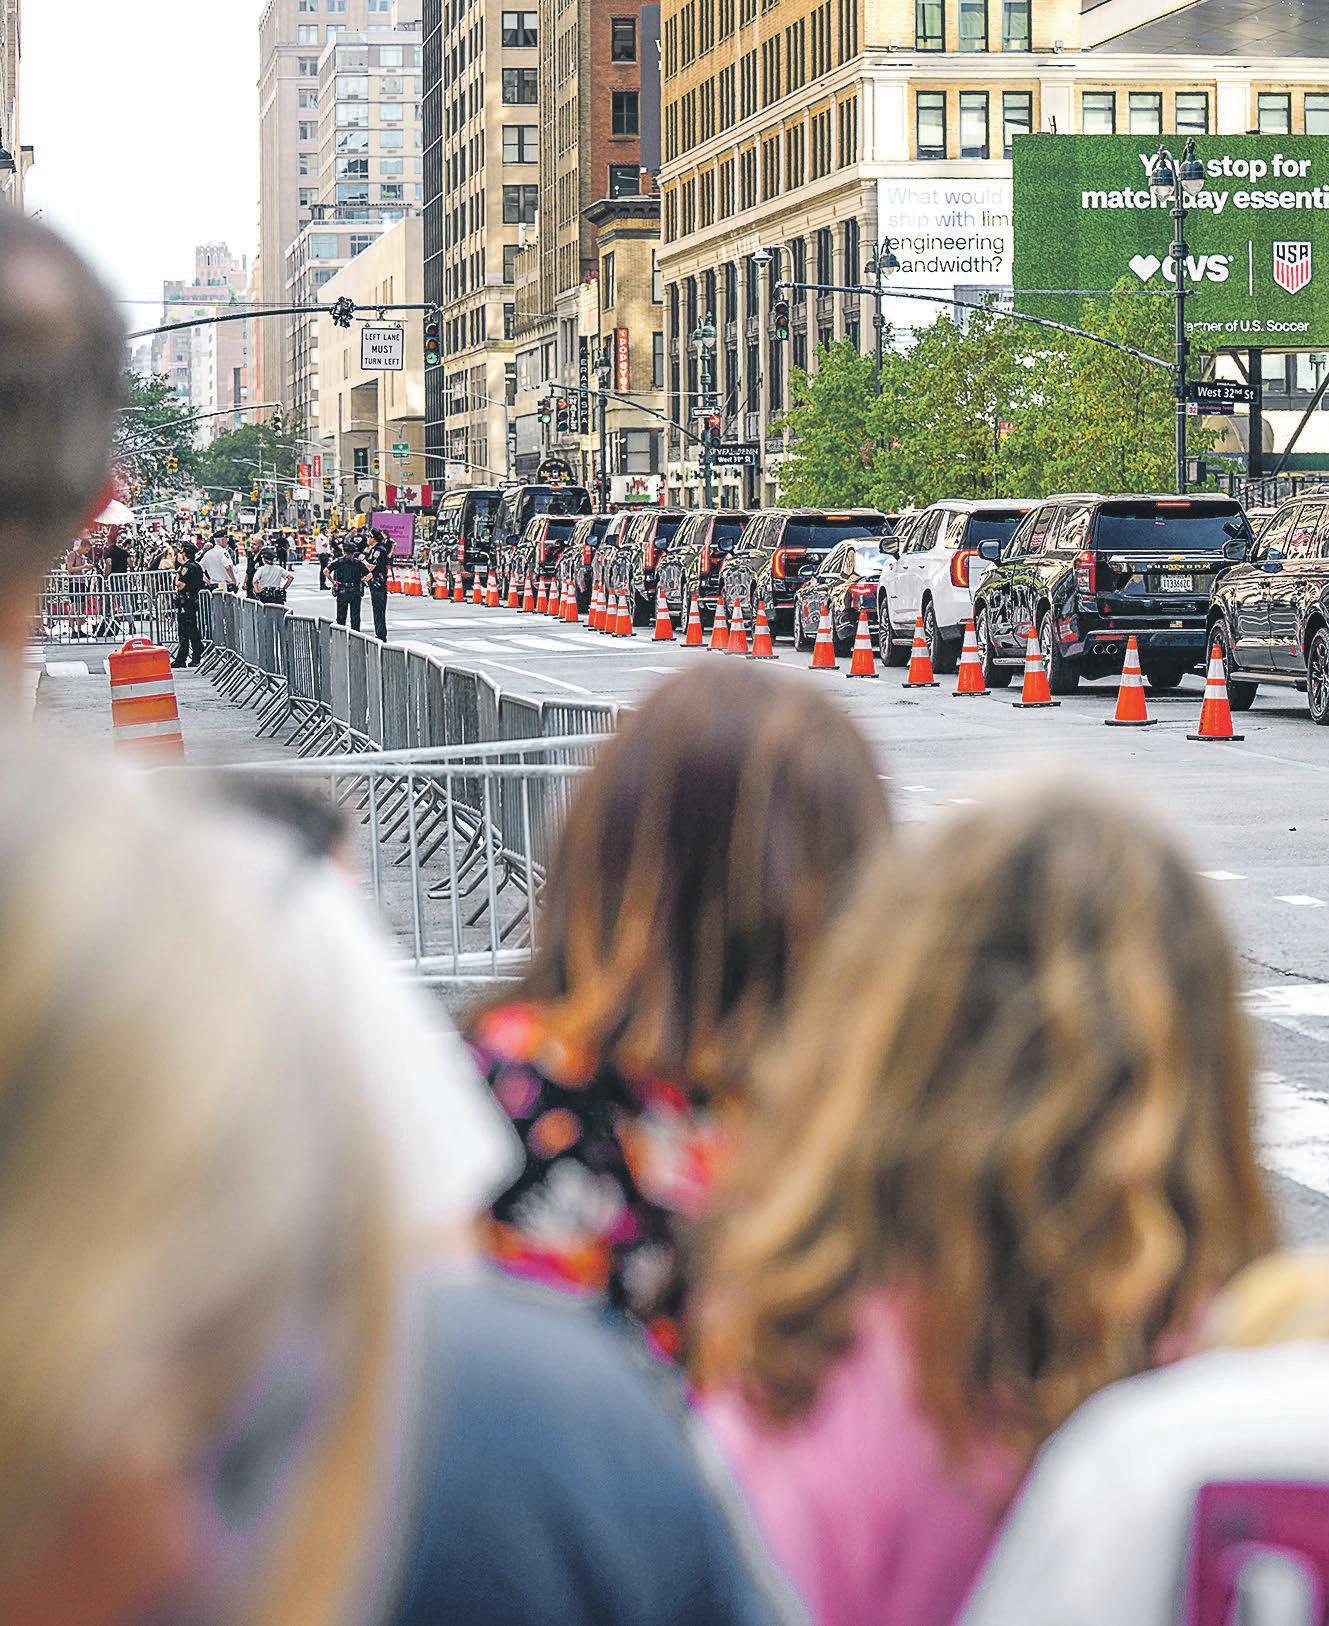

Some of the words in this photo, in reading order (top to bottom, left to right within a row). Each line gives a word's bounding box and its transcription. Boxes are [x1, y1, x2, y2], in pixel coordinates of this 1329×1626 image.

[1207, 155, 1267, 183] stop
[1272, 153, 1311, 178] for
[888, 186, 938, 205] What
[944, 186, 1003, 205] would
[935, 210, 976, 227] with
[889, 233, 1004, 254] engineering
[1276, 244, 1309, 264] USA
[896, 256, 1003, 273] andwidth?
[1225, 319, 1239, 332] of
[1240, 320, 1264, 332] U.S.
[1266, 320, 1310, 332] Soccer
[365, 333, 380, 341] LEFT
[383, 333, 400, 341] LANE
[371, 345, 393, 354] MUST
[365, 357, 382, 365] TURN
[384, 358, 400, 366] LEFT
[1197, 386, 1222, 398] West
[1223, 387, 1243, 399] 32nd
[1244, 389, 1255, 400] St
